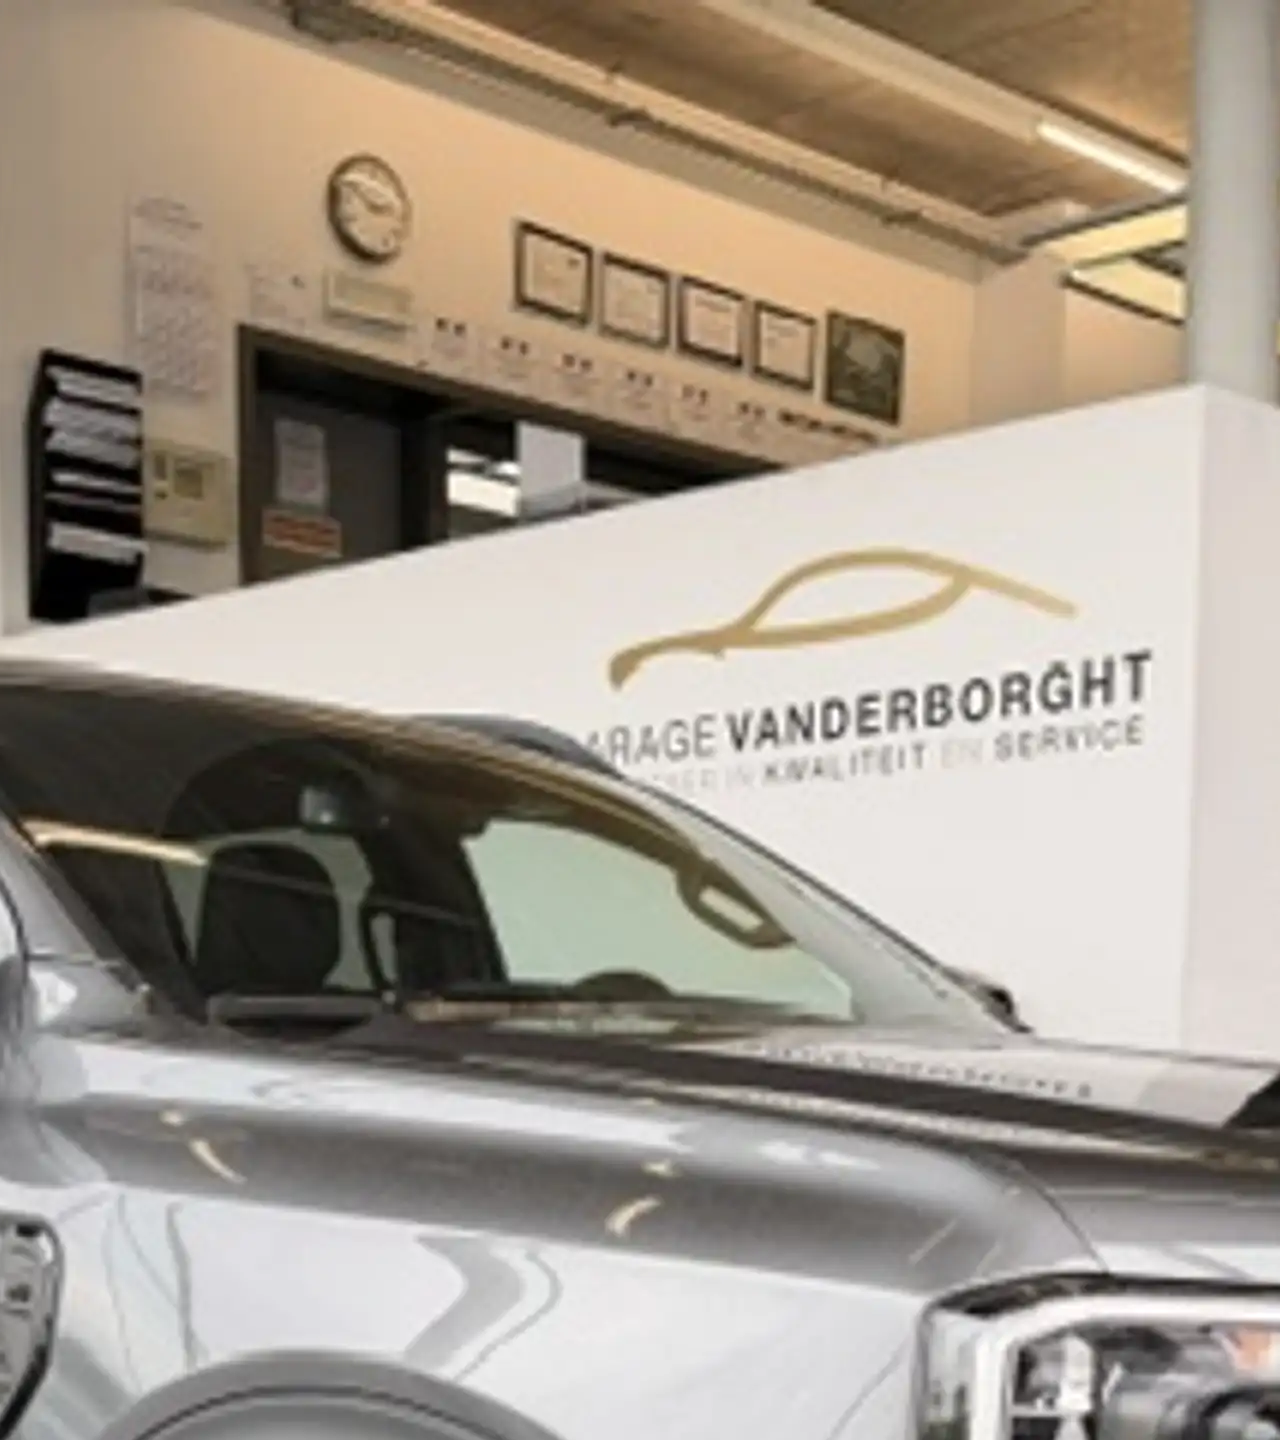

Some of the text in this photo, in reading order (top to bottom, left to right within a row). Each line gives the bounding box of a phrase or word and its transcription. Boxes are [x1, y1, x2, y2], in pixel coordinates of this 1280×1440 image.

[725, 648, 1153, 752] VANDERBORGHT
[763, 741, 925, 786] KWALITEIT
[994, 713, 1143, 762] SERVICE
